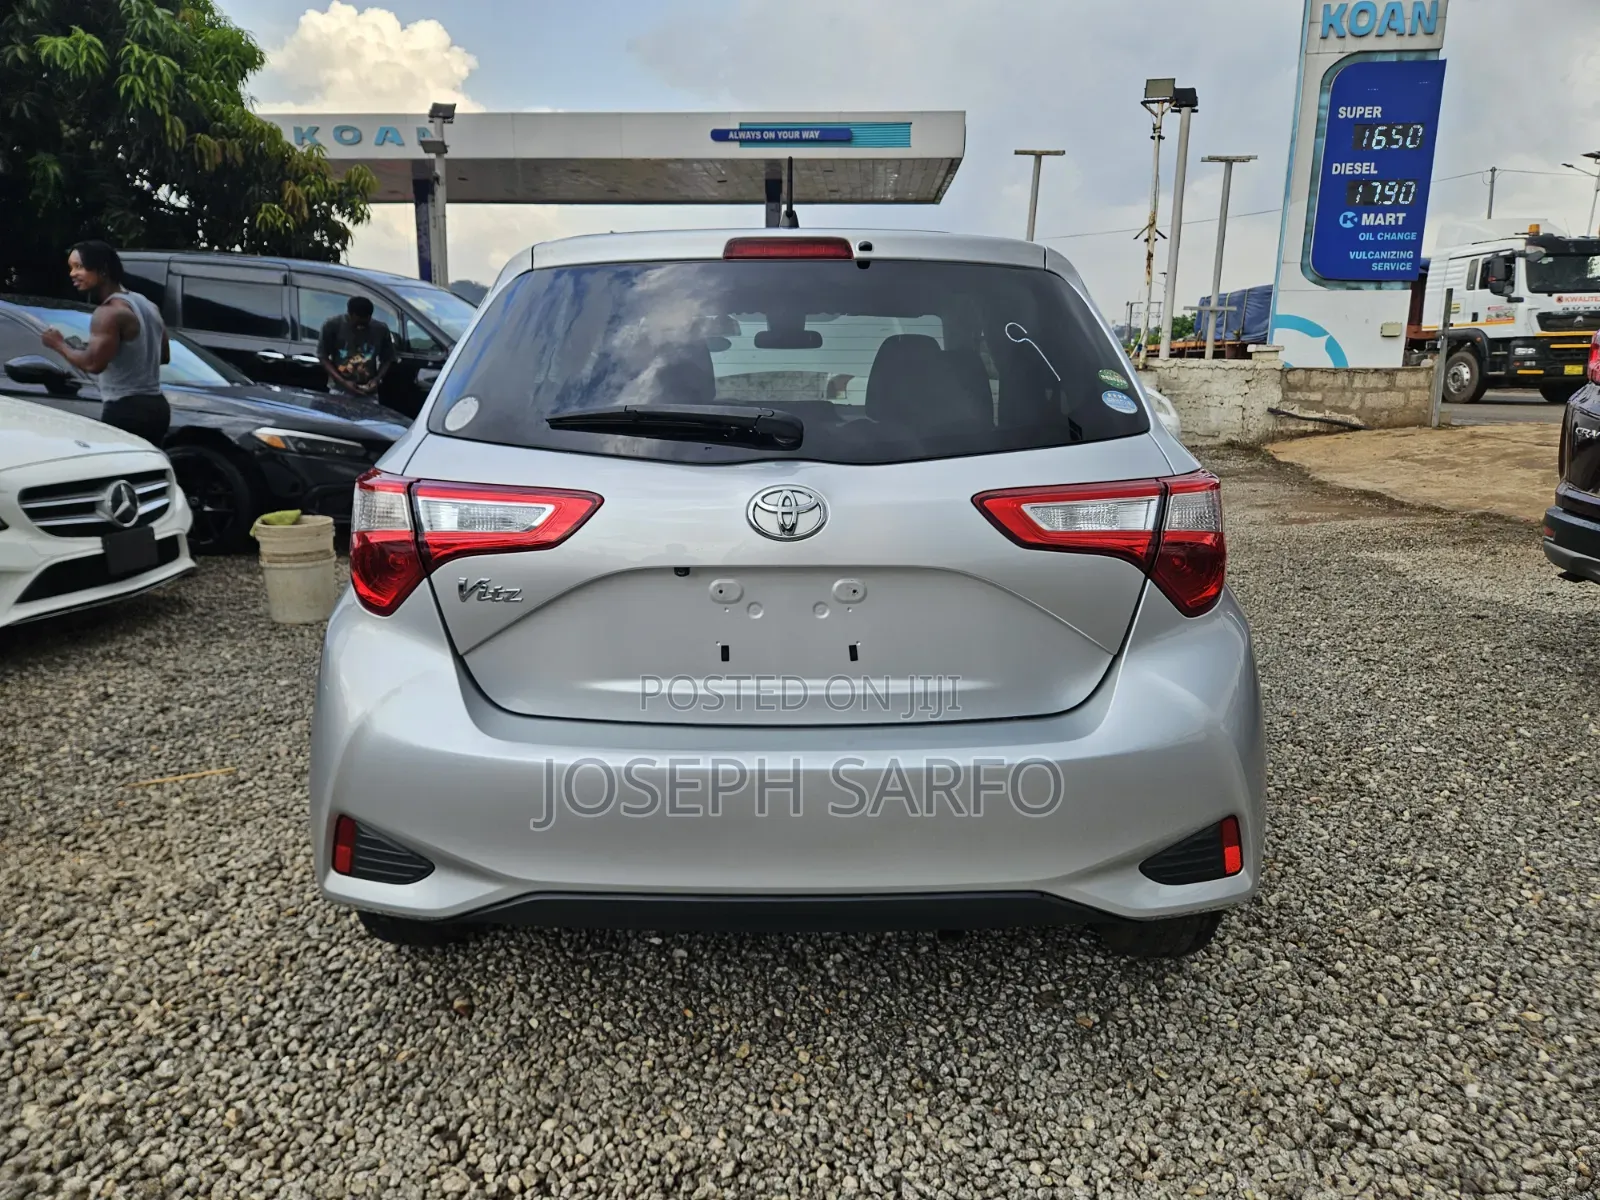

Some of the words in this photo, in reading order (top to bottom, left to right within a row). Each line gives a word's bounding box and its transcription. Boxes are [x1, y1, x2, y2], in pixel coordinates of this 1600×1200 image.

[1320, 0, 1438, 39] KOAN
[1338, 106, 1382, 118] SUPER
[728, 131, 761, 139] ALWAYS
[763, 131, 775, 139] ON
[777, 131, 800, 139] YOUR
[802, 130, 820, 139] WAY
[1332, 162, 1378, 174] DIESEL
[1361, 213, 1406, 226] MART
[1377, 232, 1417, 240] CHANGE
[1349, 251, 1414, 259] VULCANIZING
[1371, 262, 1412, 271] SERVICE
[458, 577, 523, 602] Vitz
